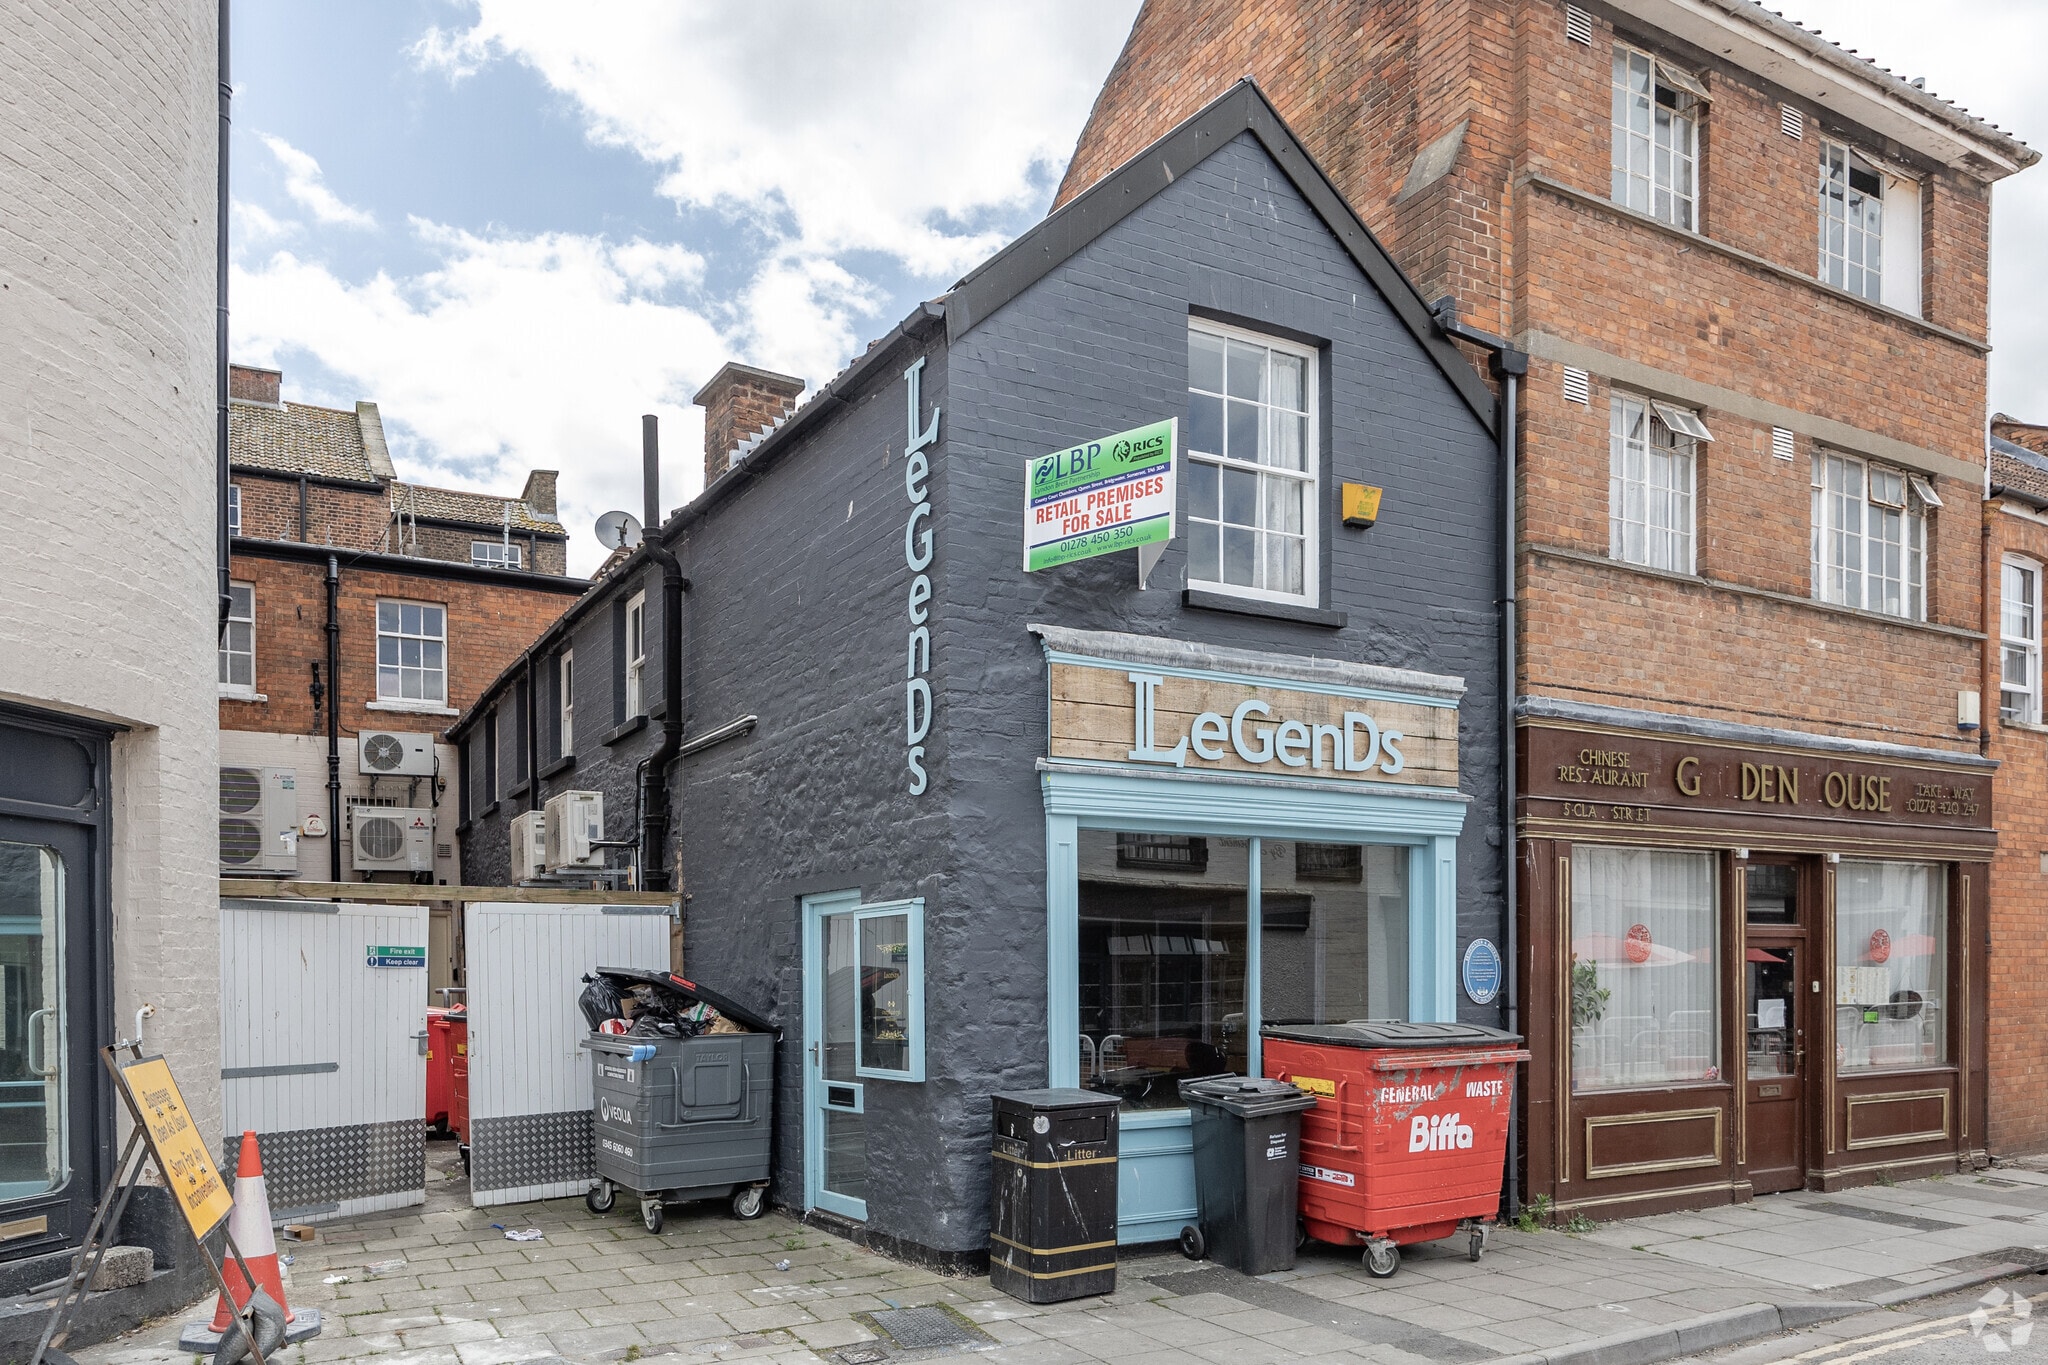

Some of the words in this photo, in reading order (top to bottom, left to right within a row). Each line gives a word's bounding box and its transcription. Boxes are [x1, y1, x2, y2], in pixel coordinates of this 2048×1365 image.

[1133, 436, 1164, 452] RICS
[1056, 443, 1101, 479] LBP
[1036, 498, 1081, 524] RETAIL
[1087, 476, 1164, 511] PREMISES
[1062, 515, 1090, 535] FOR
[1096, 503, 1132, 527] SALE
[1060, 537, 1087, 552] 01278
[1091, 531, 1110, 544] 450
[1113, 526, 1133, 540] 350
[1129, 672, 1404, 775] LeGenDs
[1580, 749, 1630, 768] CHINESE
[385, 958, 402, 967] Keep
[696, 1052, 729, 1062] TAYLOR
[1381, 1085, 1434, 1104] GENERAL
[1466, 1081, 1503, 1098] WASTE
[609, 1106, 632, 1125] VEOLIA
[153, 1124, 169, 1146] Open
[164, 1118, 176, 1137] As
[1409, 1112, 1474, 1153] Biffa
[1067, 1150, 1097, 1161] Litter
[169, 1158, 189, 1178] Sorry
